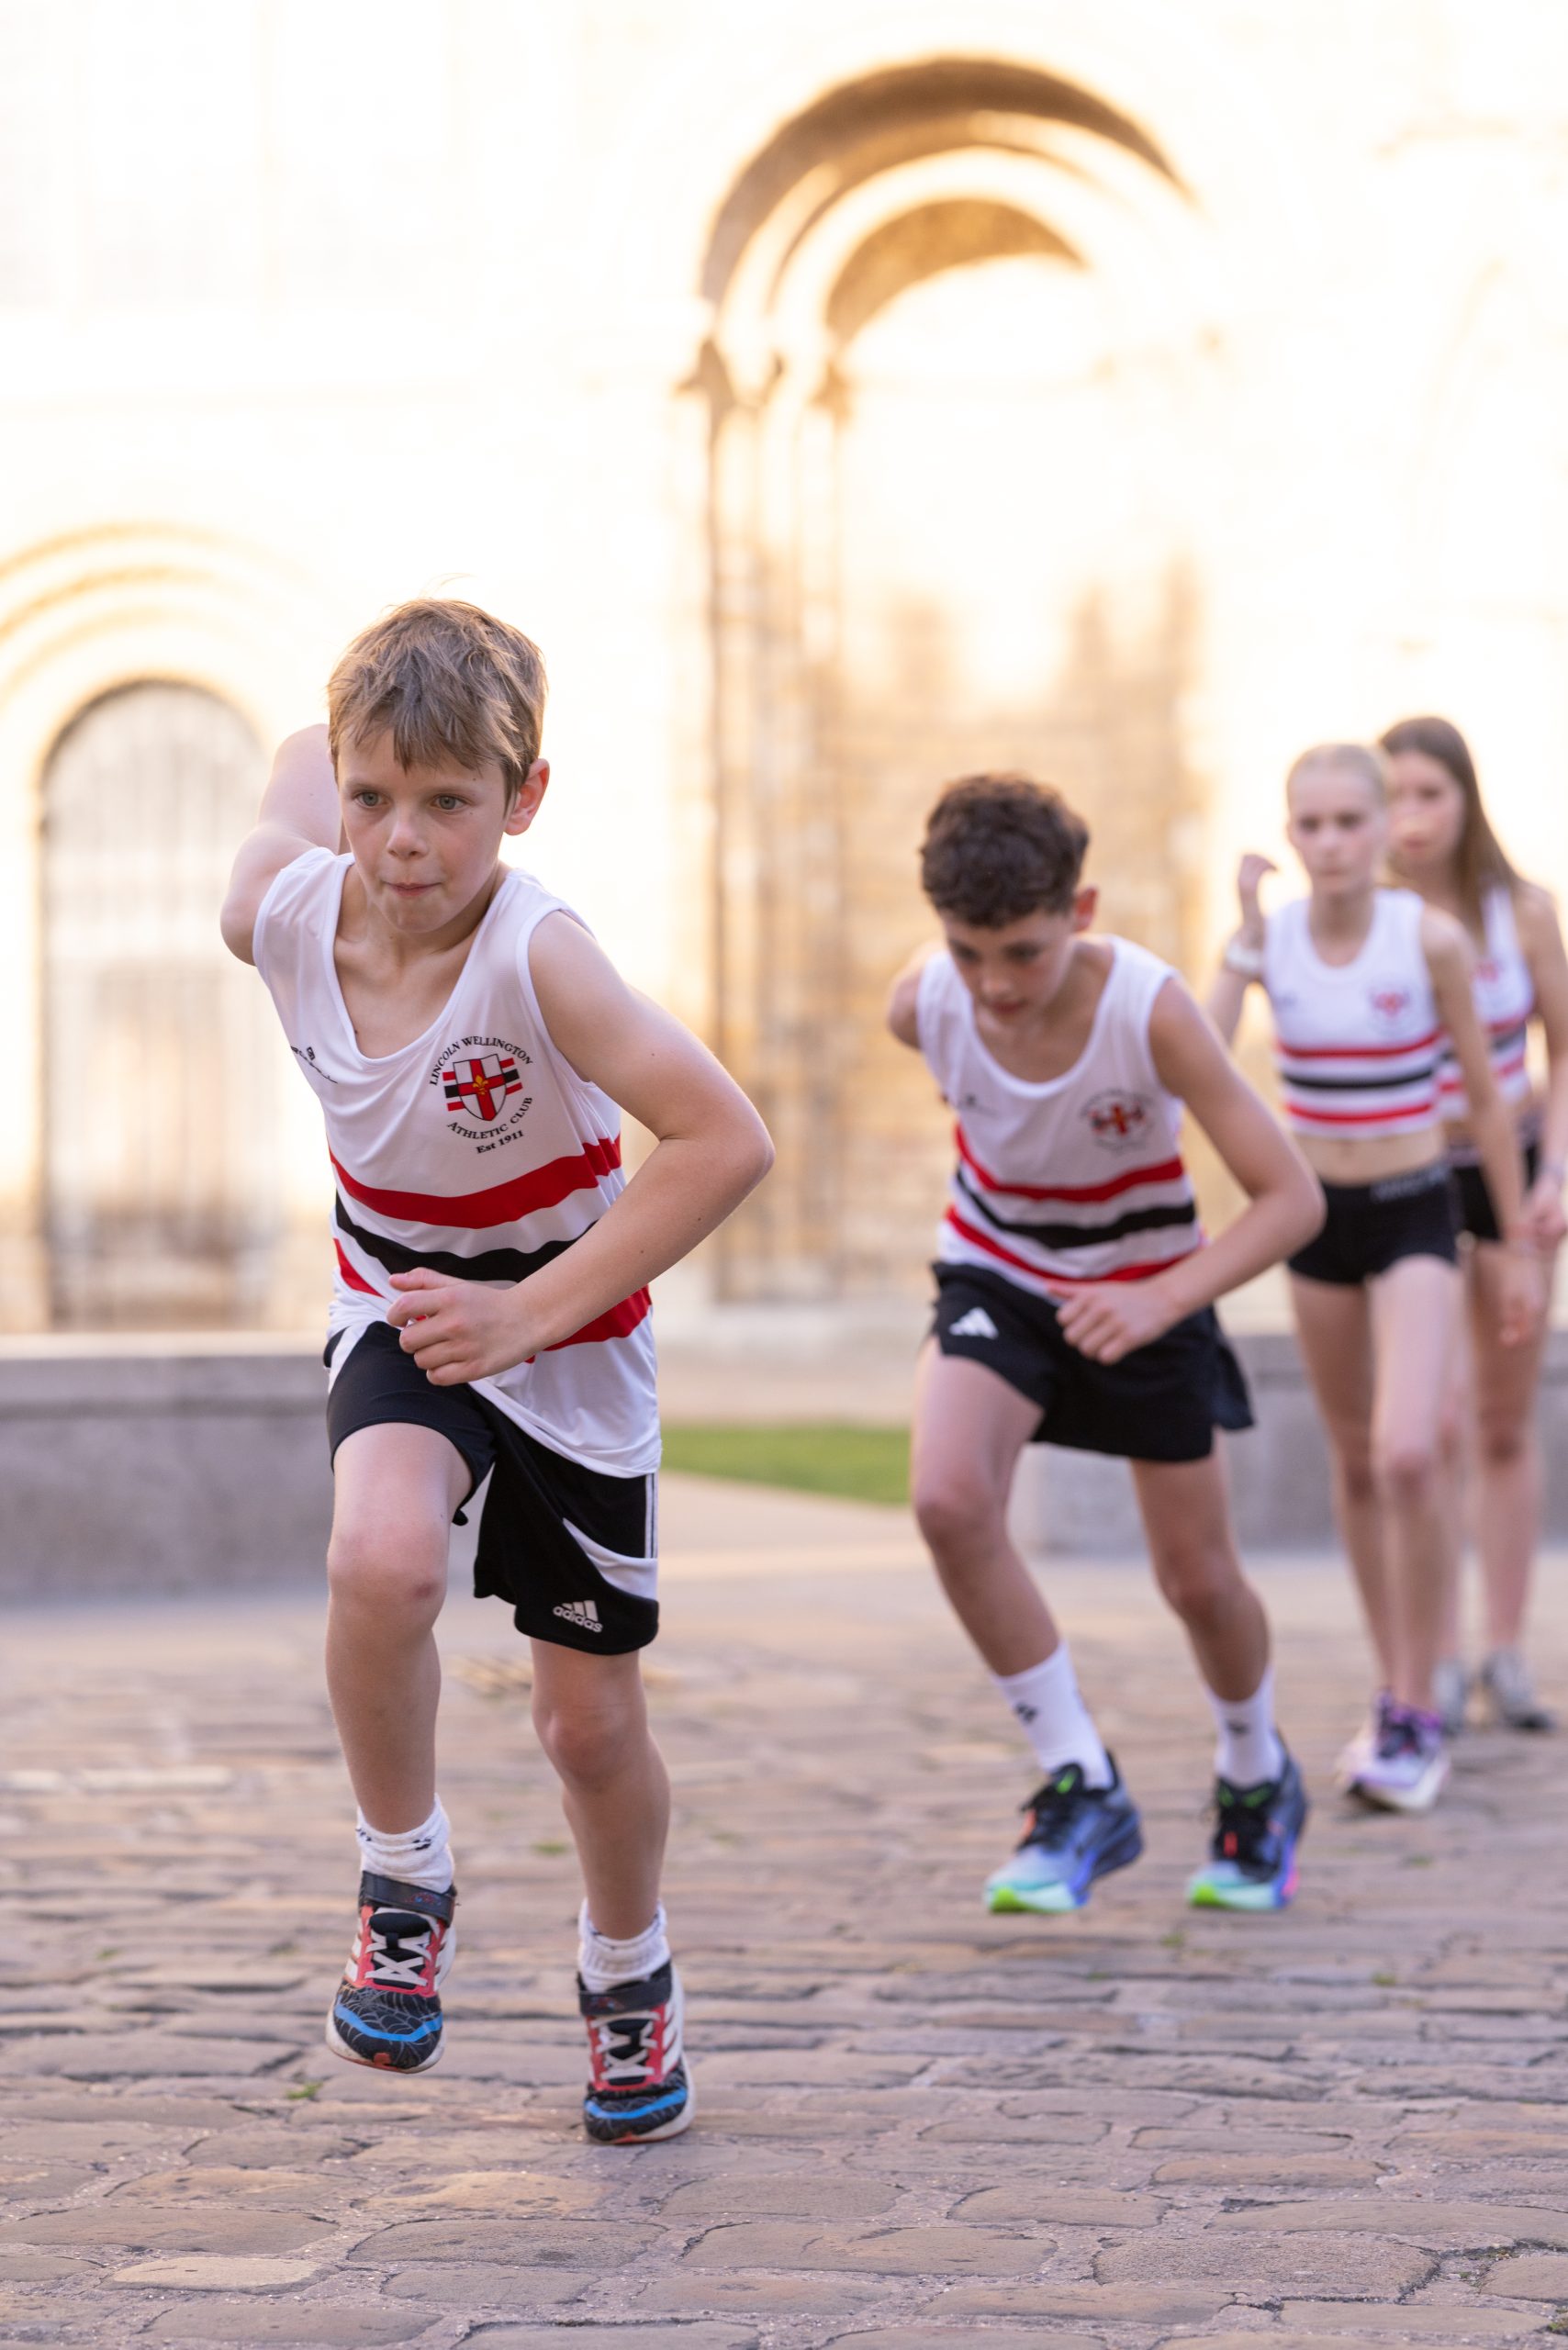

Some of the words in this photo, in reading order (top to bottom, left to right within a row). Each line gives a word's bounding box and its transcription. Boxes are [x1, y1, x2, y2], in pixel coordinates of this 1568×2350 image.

[429, 1041, 461, 1086] LINCOLN
[461, 1035, 533, 1065] WELLINGTON
[447, 1122, 509, 1140] ATHLETIC
[510, 1097, 533, 1125] CLUB
[476, 1142, 496, 1154] Est
[498, 1130, 524, 1146] 1911
[553, 1606, 603, 1632] adidas
